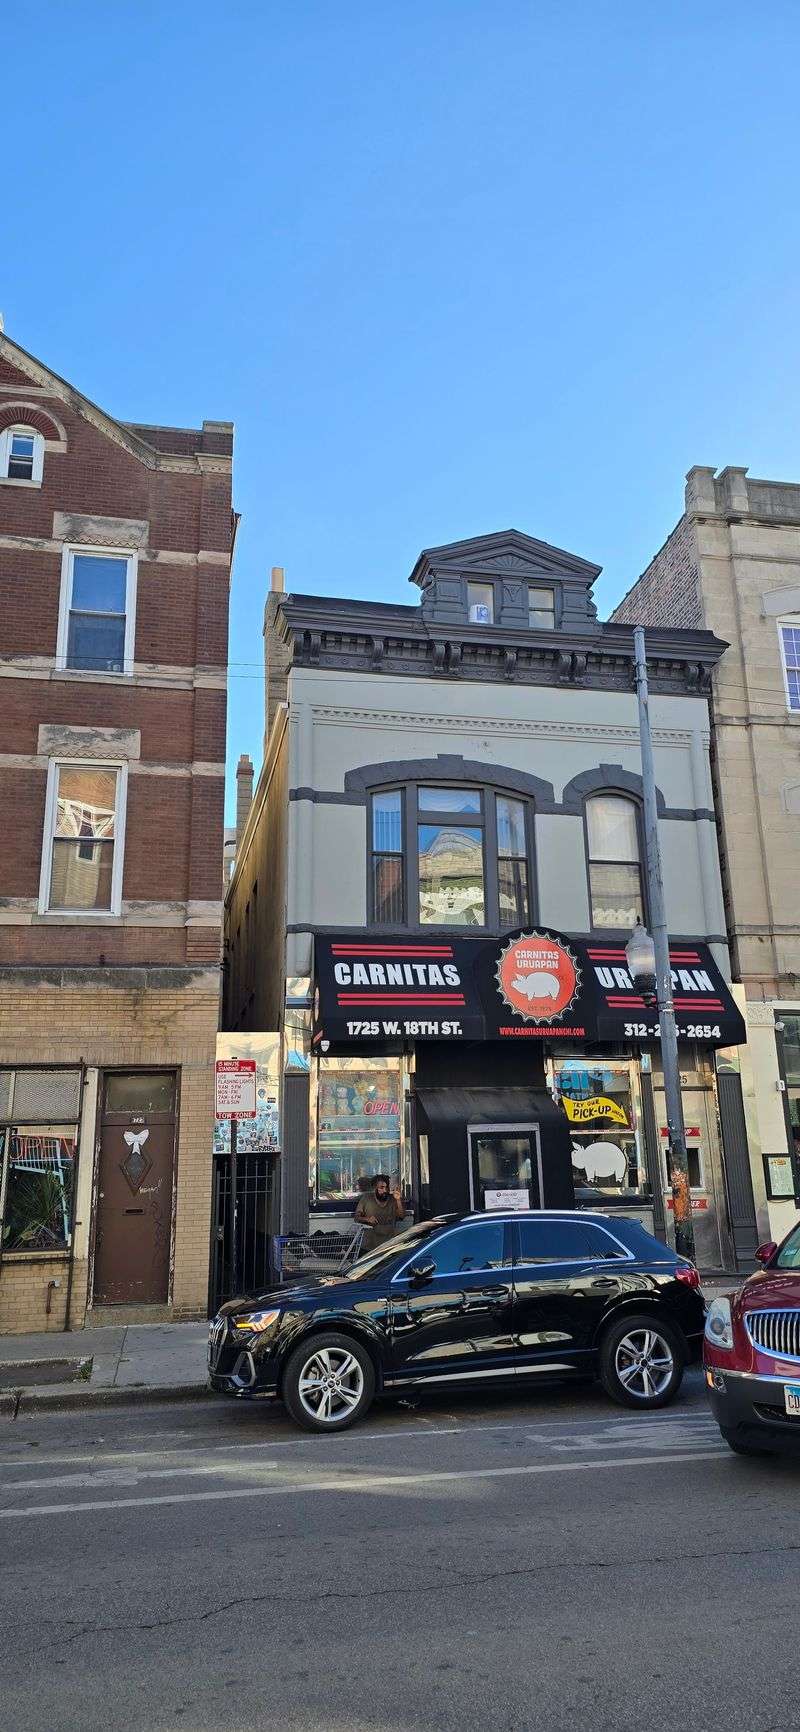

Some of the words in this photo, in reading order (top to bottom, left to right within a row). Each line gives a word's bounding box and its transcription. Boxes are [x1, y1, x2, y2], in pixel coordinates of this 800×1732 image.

[515, 950, 559, 959] CARNITAS
[517, 960, 559, 969] URUAPAN
[334, 962, 461, 986] CARNITAS
[594, 967, 715, 991] URPAN
[347, 1021, 380, 1035] 1725
[383, 1021, 401, 1035] W.
[403, 1021, 439, 1035] 18TH
[441, 1022, 463, 1035] ST.
[499, 1027, 585, 1036] WWW.CARNITASURUAPANCHI.COM
[624, 1023, 721, 1038] 312-26-2654
[364, 1101, 400, 1115] OPEN
[573, 1105, 612, 1118] PICK-UP
[9, 1135, 75, 1160] OPEN
